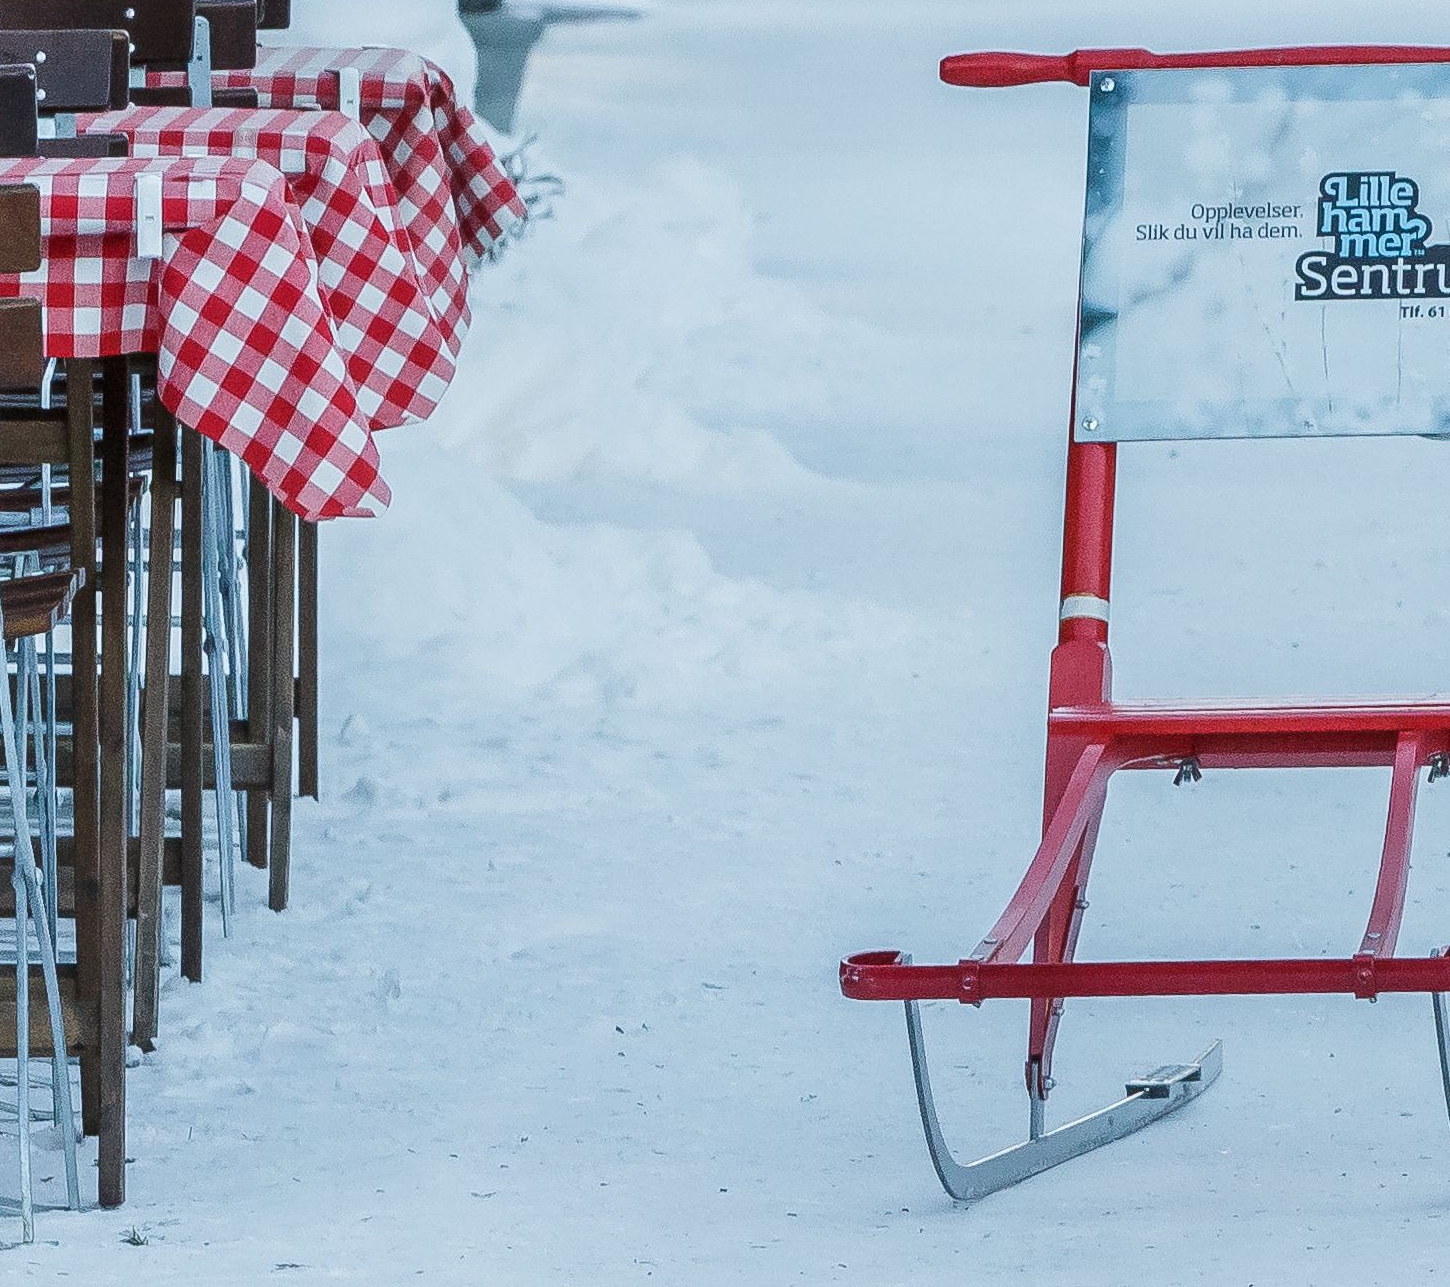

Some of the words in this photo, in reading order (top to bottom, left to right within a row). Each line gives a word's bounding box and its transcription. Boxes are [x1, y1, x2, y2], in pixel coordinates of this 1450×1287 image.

[1325, 175, 1413, 207] Lille
[1321, 202, 1415, 233] ham
[1136, 224, 1169, 241] Slik
[1174, 224, 1197, 240] du
[1202, 223, 1224, 239] vil
[1230, 223, 1253, 239] ha
[1257, 222, 1303, 238] dem.
[1339, 231, 1413, 257] mer
[1428, 305, 1445, 317] 61
